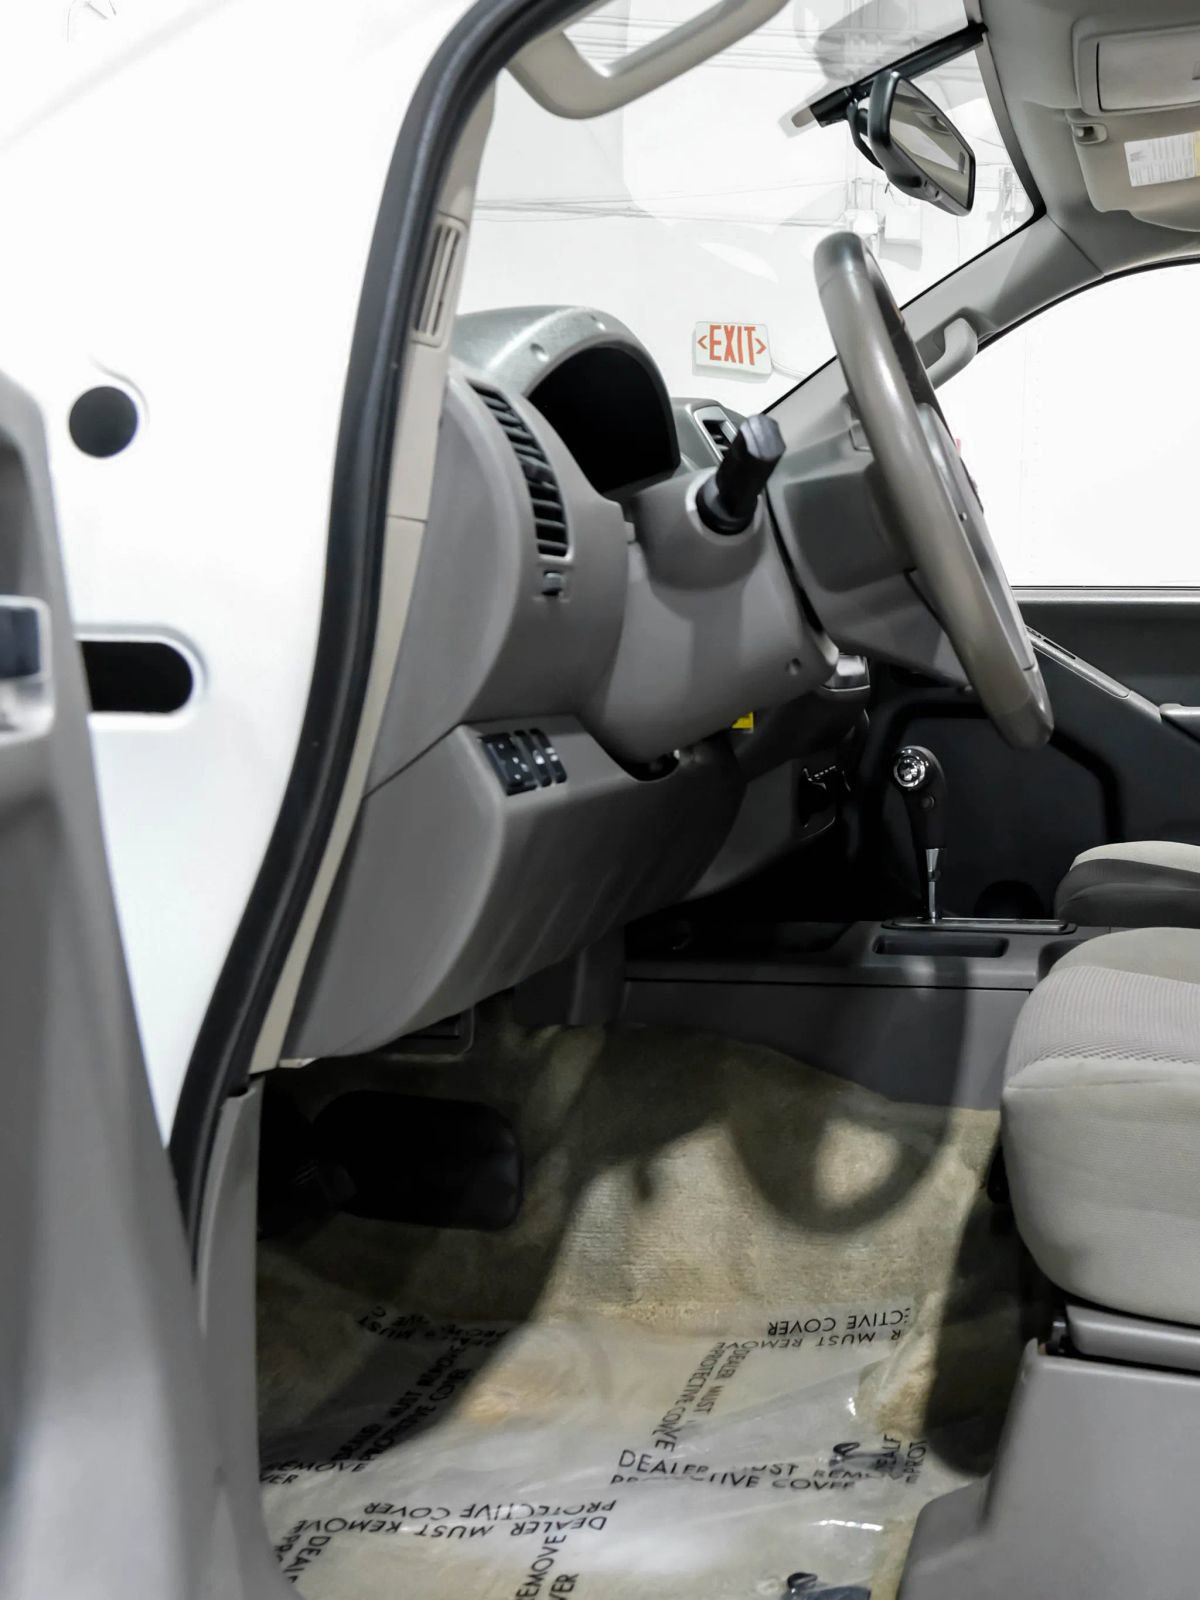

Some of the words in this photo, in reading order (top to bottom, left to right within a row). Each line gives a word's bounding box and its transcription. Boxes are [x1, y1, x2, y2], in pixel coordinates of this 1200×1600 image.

[709, 324, 756, 366] EXIT
[768, 1317, 836, 1336] COVER
[718, 1339, 804, 1350] REMOVE
[816, 1332, 876, 1347] MUST
[364, 1502, 451, 1521] COVER
[459, 1499, 617, 1521] PROTECTIVE
[294, 1517, 401, 1533] REMOVE
[413, 1525, 495, 1539] MUST
[510, 1516, 608, 1537] DEALER
